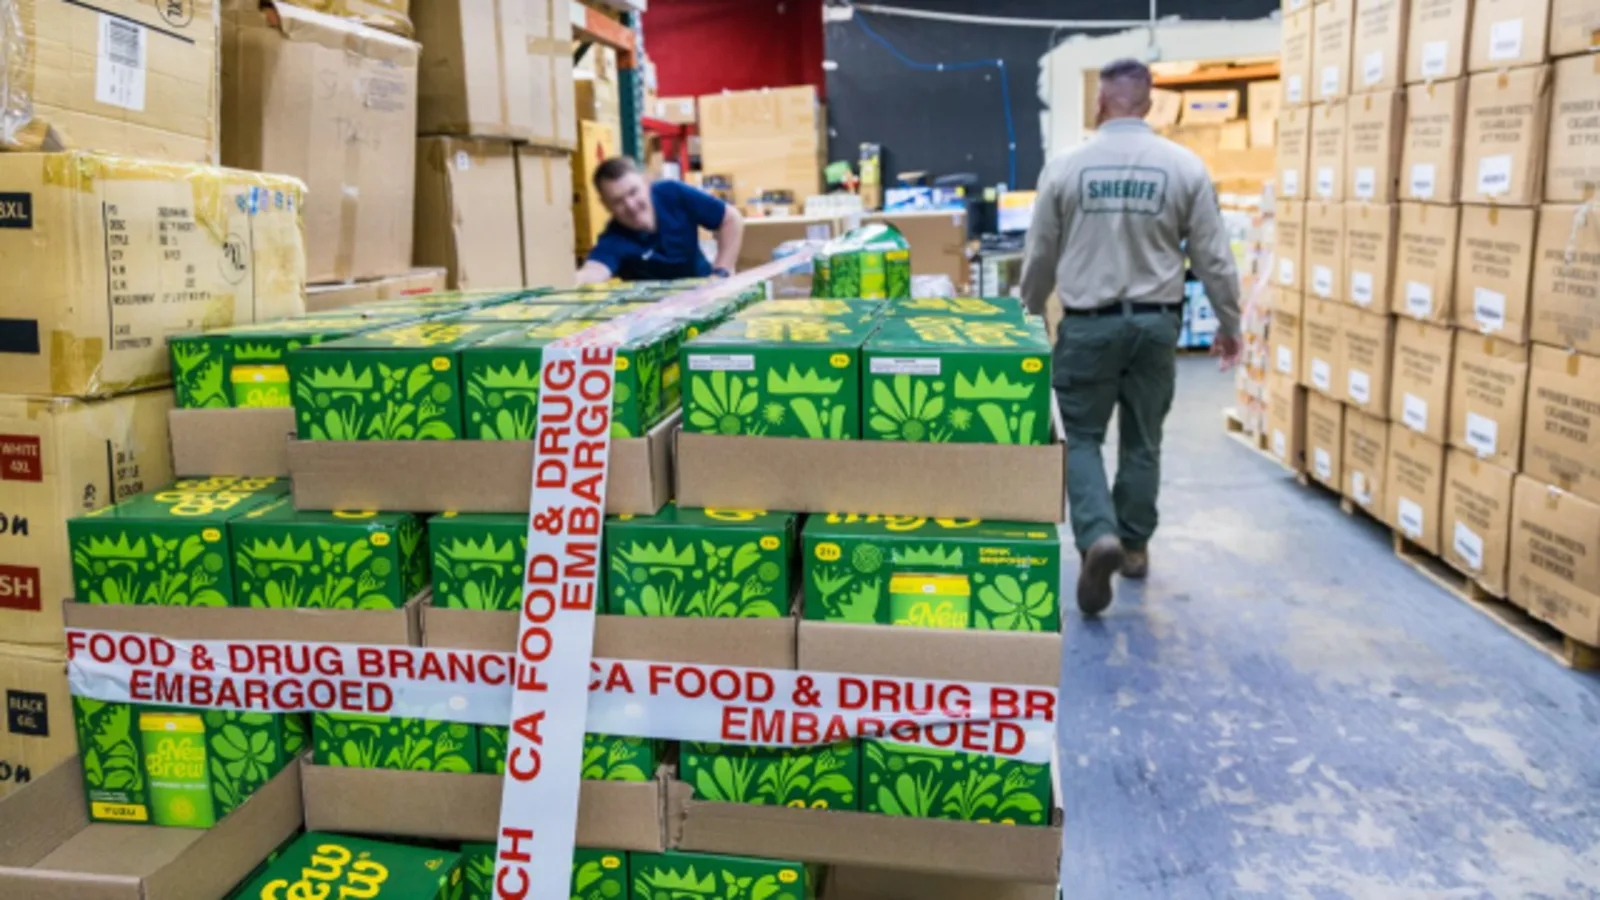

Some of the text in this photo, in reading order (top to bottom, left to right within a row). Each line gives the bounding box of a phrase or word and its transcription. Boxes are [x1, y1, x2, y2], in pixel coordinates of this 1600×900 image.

[1088, 180, 1157, 200] SHERIFF
[66, 631, 176, 667] FOOD
[190, 644, 214, 672] &
[228, 643, 344, 676] DRUG
[496, 360, 577, 900] CH CA FOOD & DRUG
[130, 669, 393, 713] EMBARGOED
[648, 664, 775, 703] FOOD
[792, 675, 820, 707] &
[838, 677, 972, 718] DRUG
[989, 687, 1056, 722] BR
[721, 705, 1025, 756] EMBARGOED
